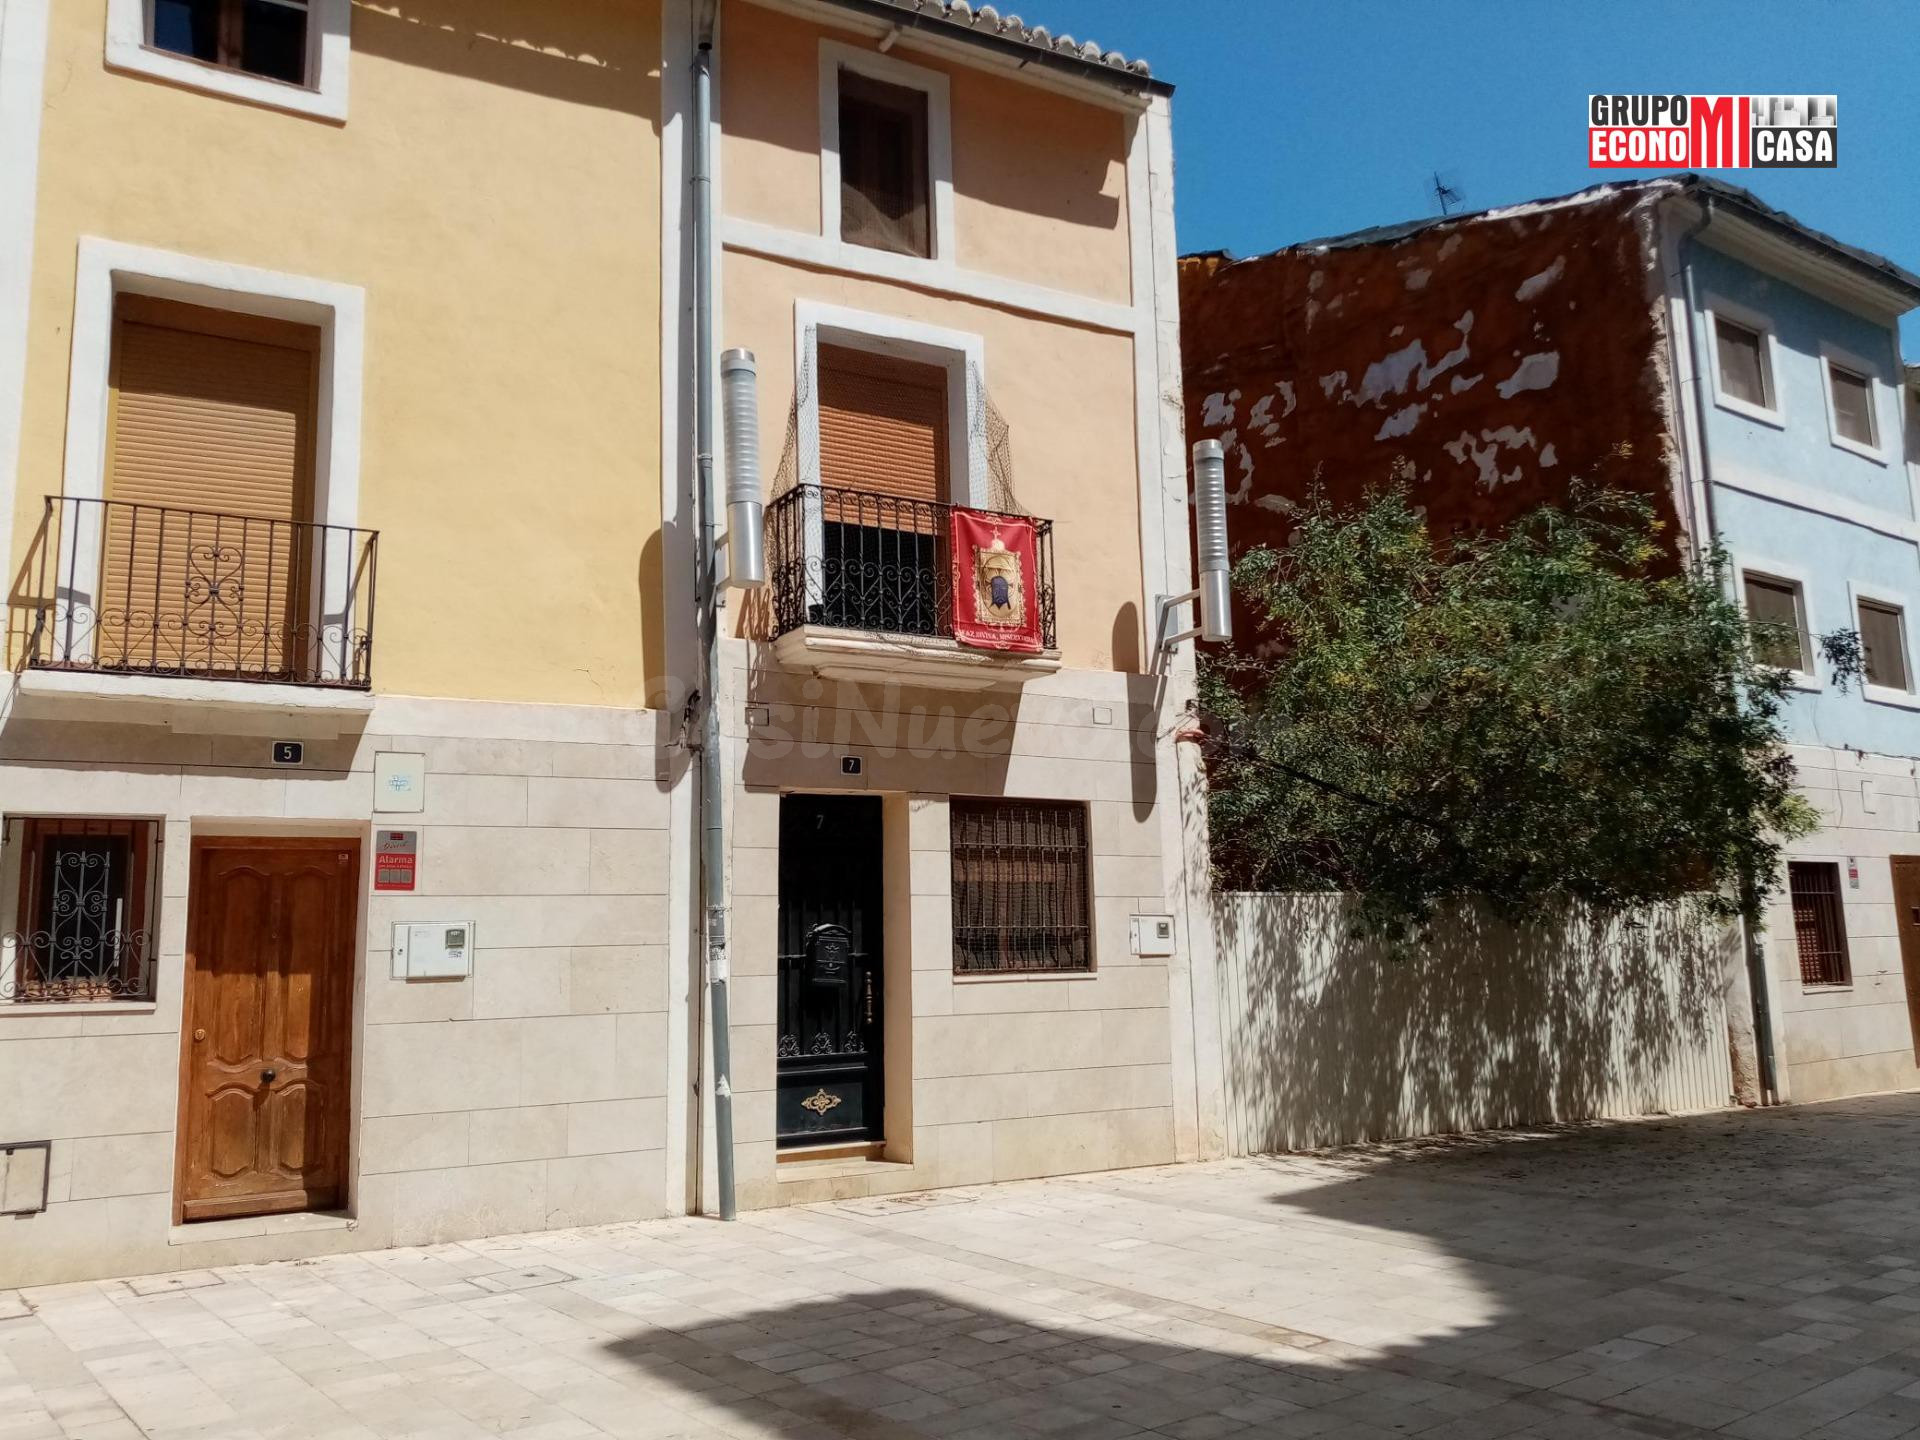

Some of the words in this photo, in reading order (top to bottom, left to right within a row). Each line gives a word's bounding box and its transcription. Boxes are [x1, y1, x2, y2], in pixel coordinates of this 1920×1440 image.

[284, 746, 292, 760] 5
[849, 759, 855, 771] 7
[816, 814, 825, 830] 7
[378, 855, 414, 865] Alarma
